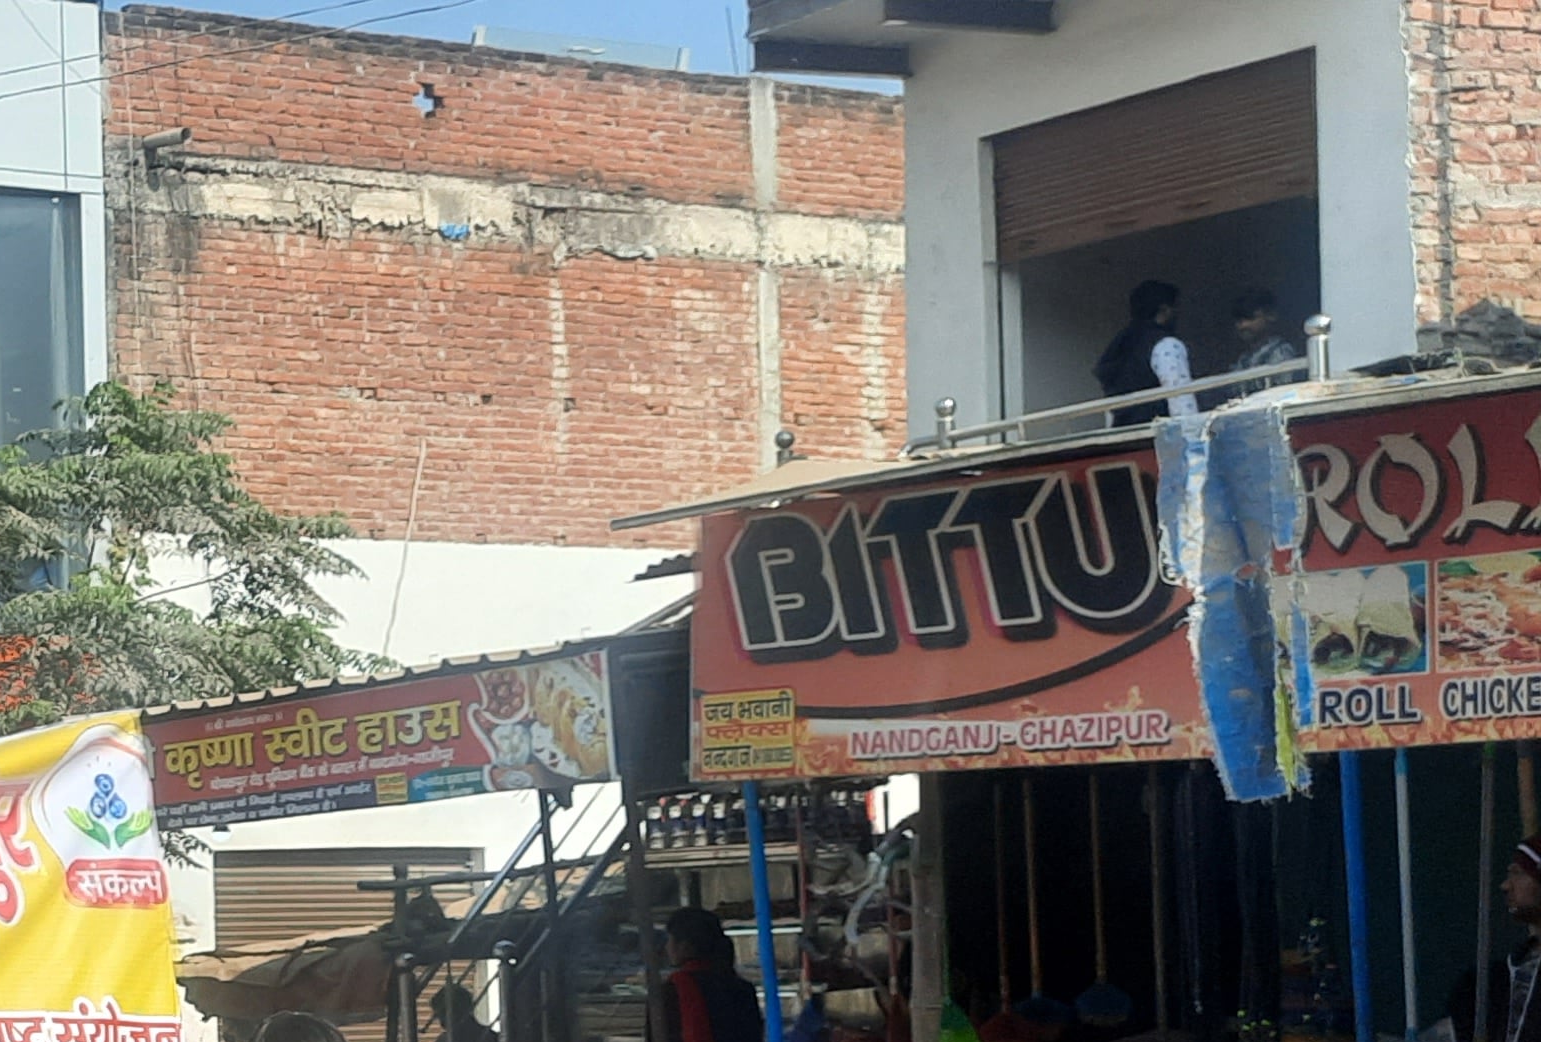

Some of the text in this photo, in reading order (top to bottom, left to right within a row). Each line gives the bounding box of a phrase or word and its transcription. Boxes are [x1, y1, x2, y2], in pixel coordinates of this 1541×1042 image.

[726, 462, 1163, 652] BITTU
[704, 690, 792, 721] जय भवानी
[1319, 672, 1541, 724] ROLL CHICKE
[164, 700, 461, 789] कृष्णा स्वीट हाउस
[1020, 713, 1165, 746] GHAZIPUR
[73, 866, 162, 902] संकल्प
